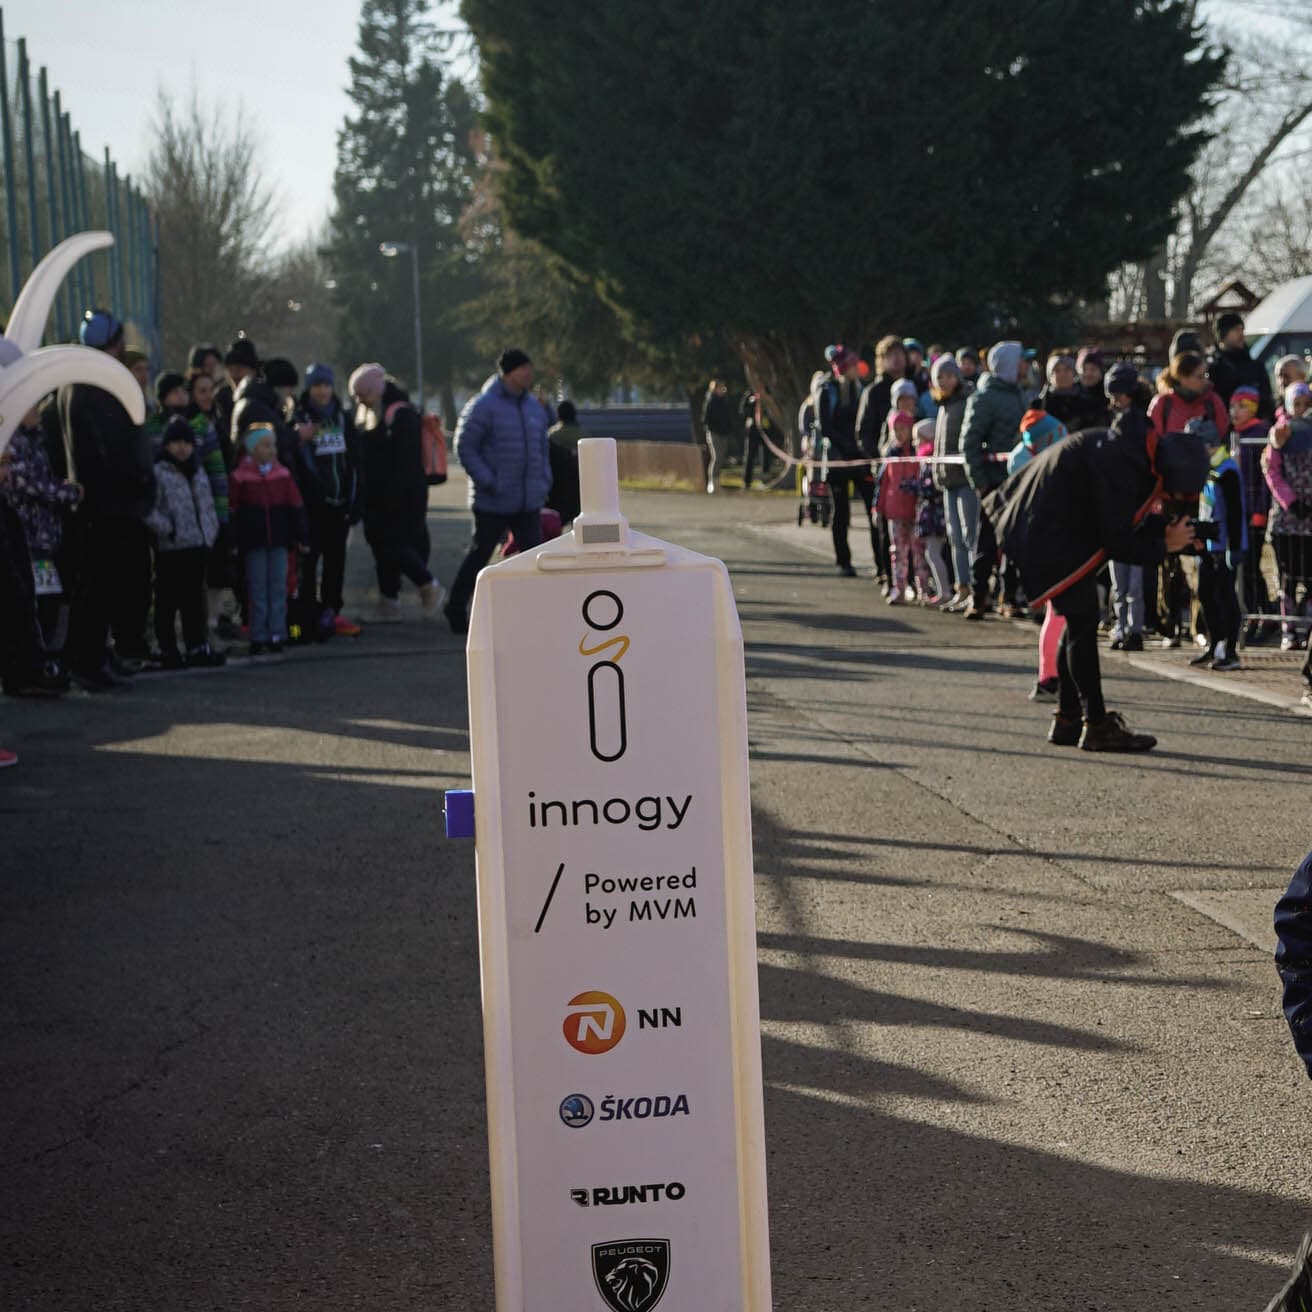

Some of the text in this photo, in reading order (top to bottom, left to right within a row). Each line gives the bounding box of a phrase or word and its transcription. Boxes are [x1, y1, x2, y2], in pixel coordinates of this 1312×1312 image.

[528, 792, 693, 831] innogy
[584, 866, 697, 894] Powered
[585, 897, 697, 930] by MVM
[636, 1007, 682, 1029] NN
[598, 1094, 691, 1121] ŠKODA
[592, 1182, 686, 1206] RUNTO
[599, 1246, 662, 1257] PEUGEOT
